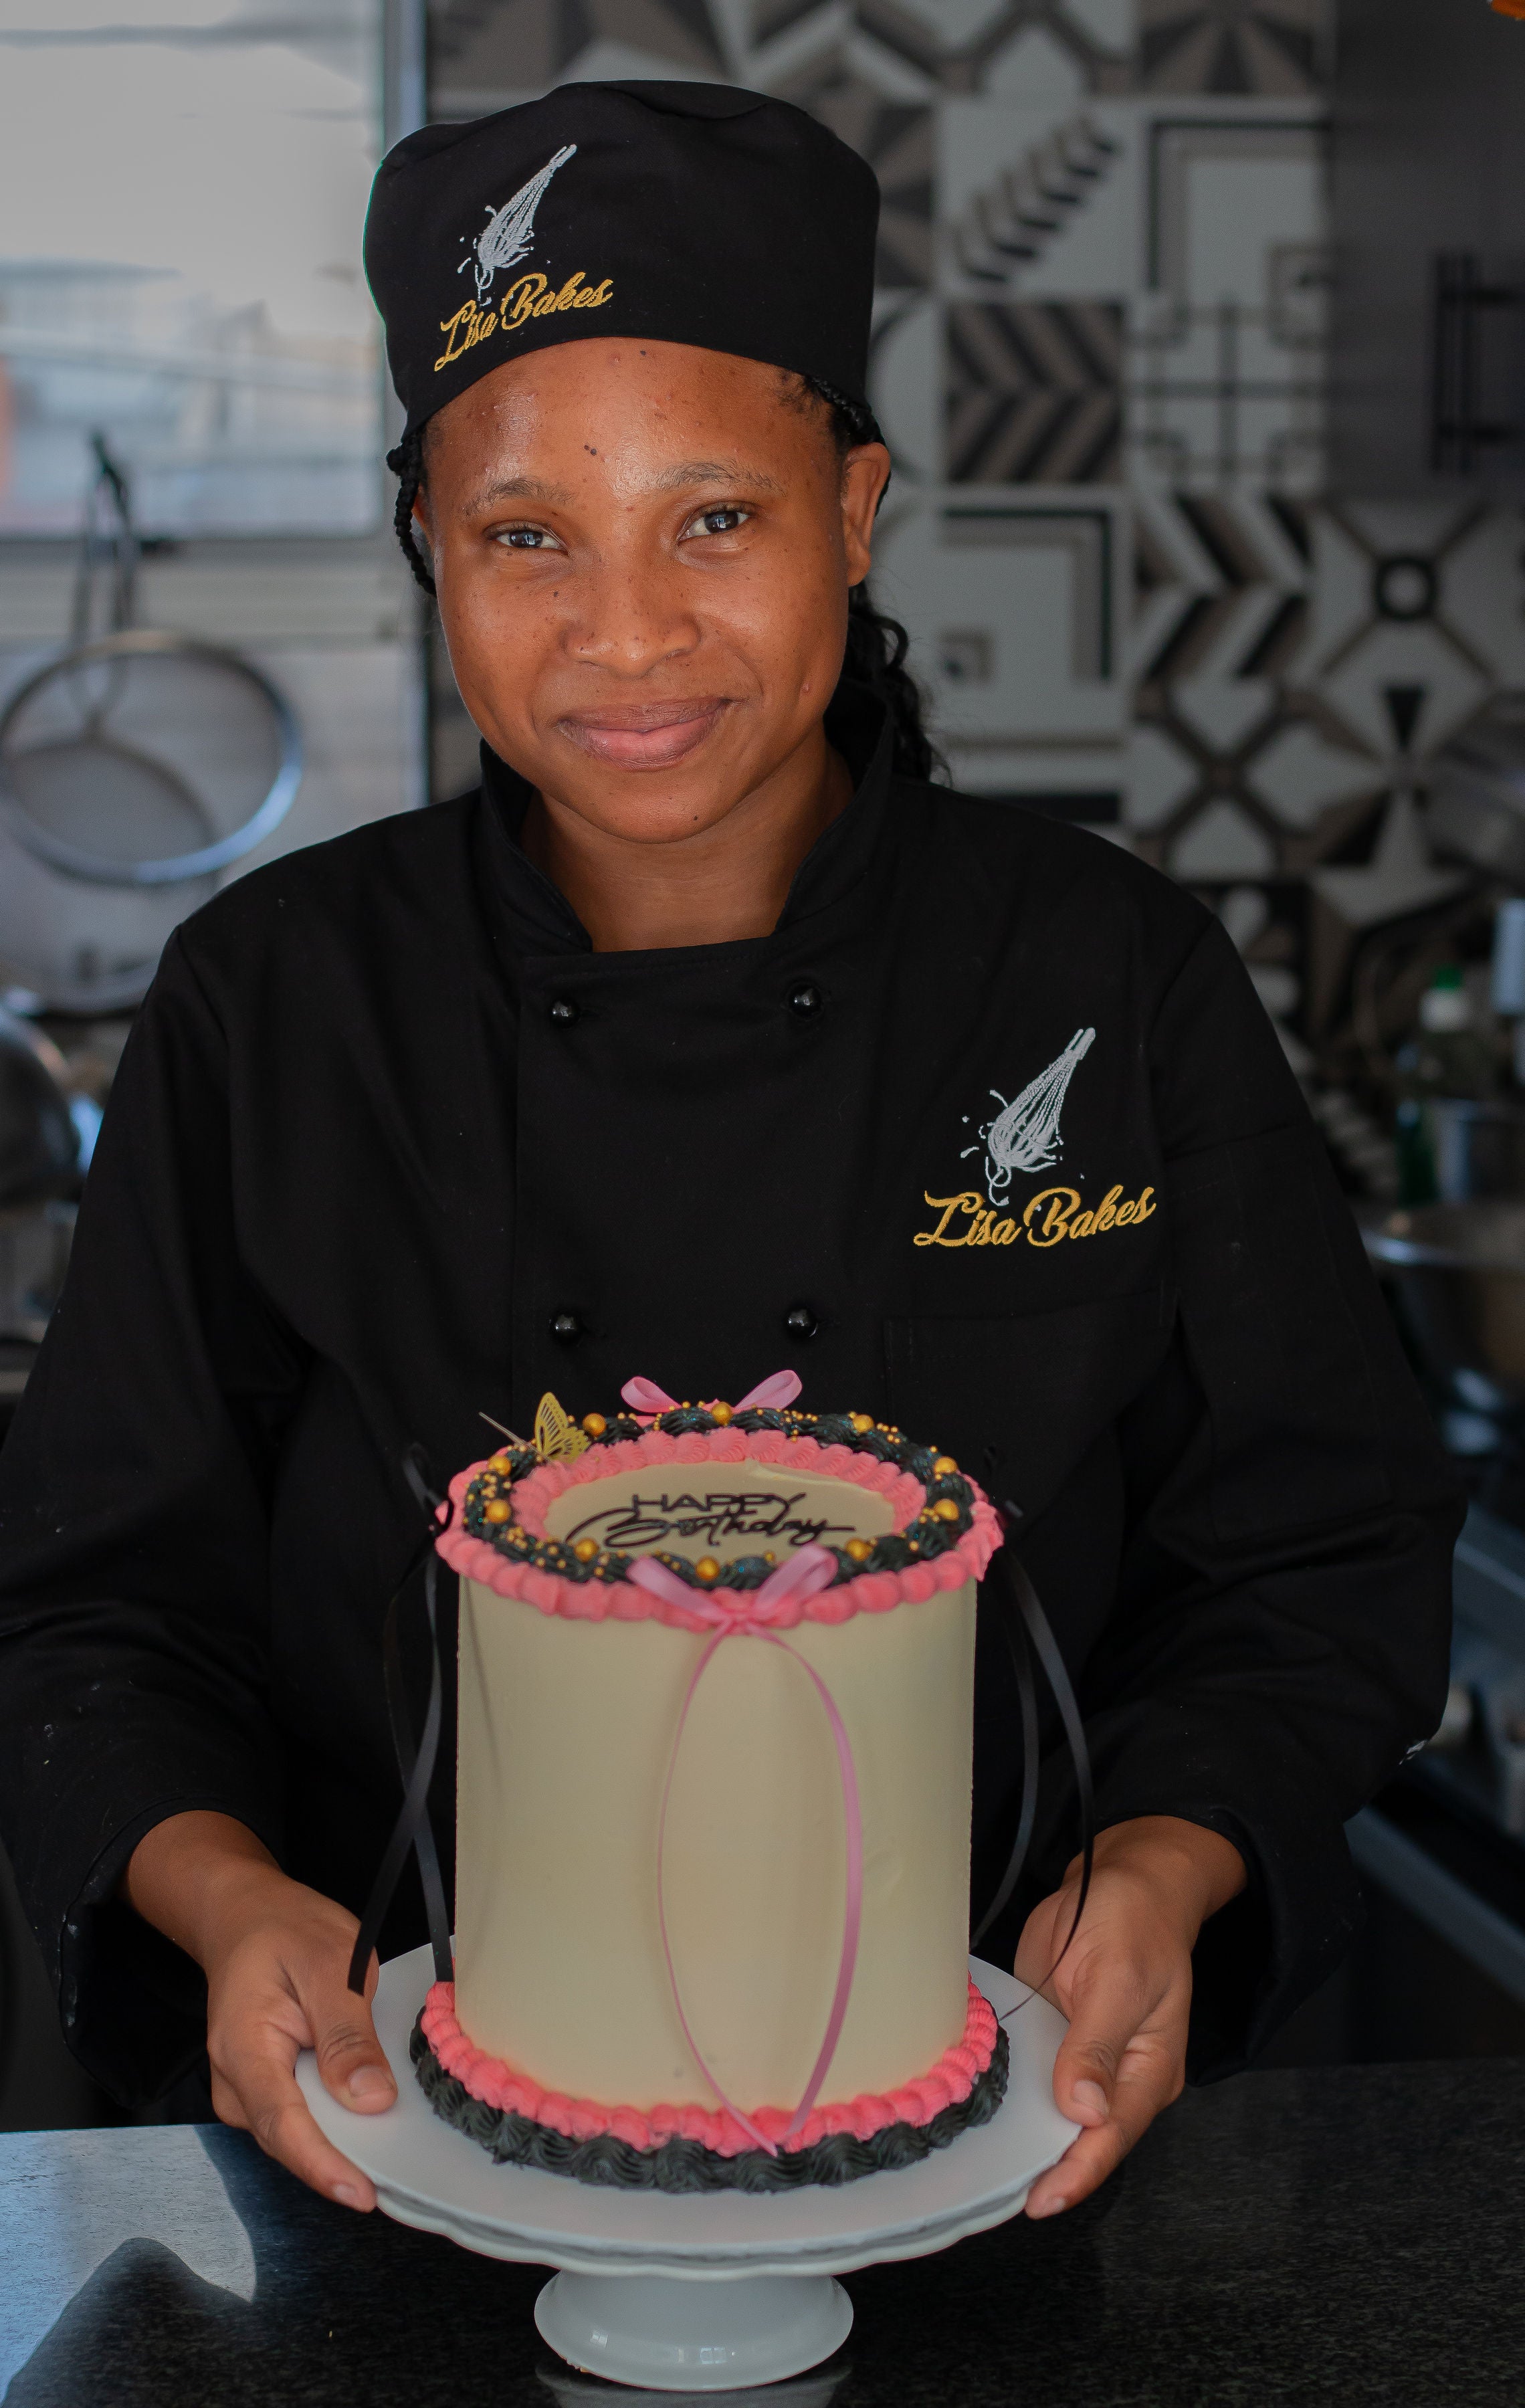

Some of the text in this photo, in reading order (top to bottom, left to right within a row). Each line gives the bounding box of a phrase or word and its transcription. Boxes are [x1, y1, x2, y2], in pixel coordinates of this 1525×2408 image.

[434, 272, 613, 371] Lisa Bakes
[913, 1185, 1156, 1247] Lisa Bakes
[565, 1508, 857, 1548] Birthday
[632, 1493, 807, 1516] HAPPY
